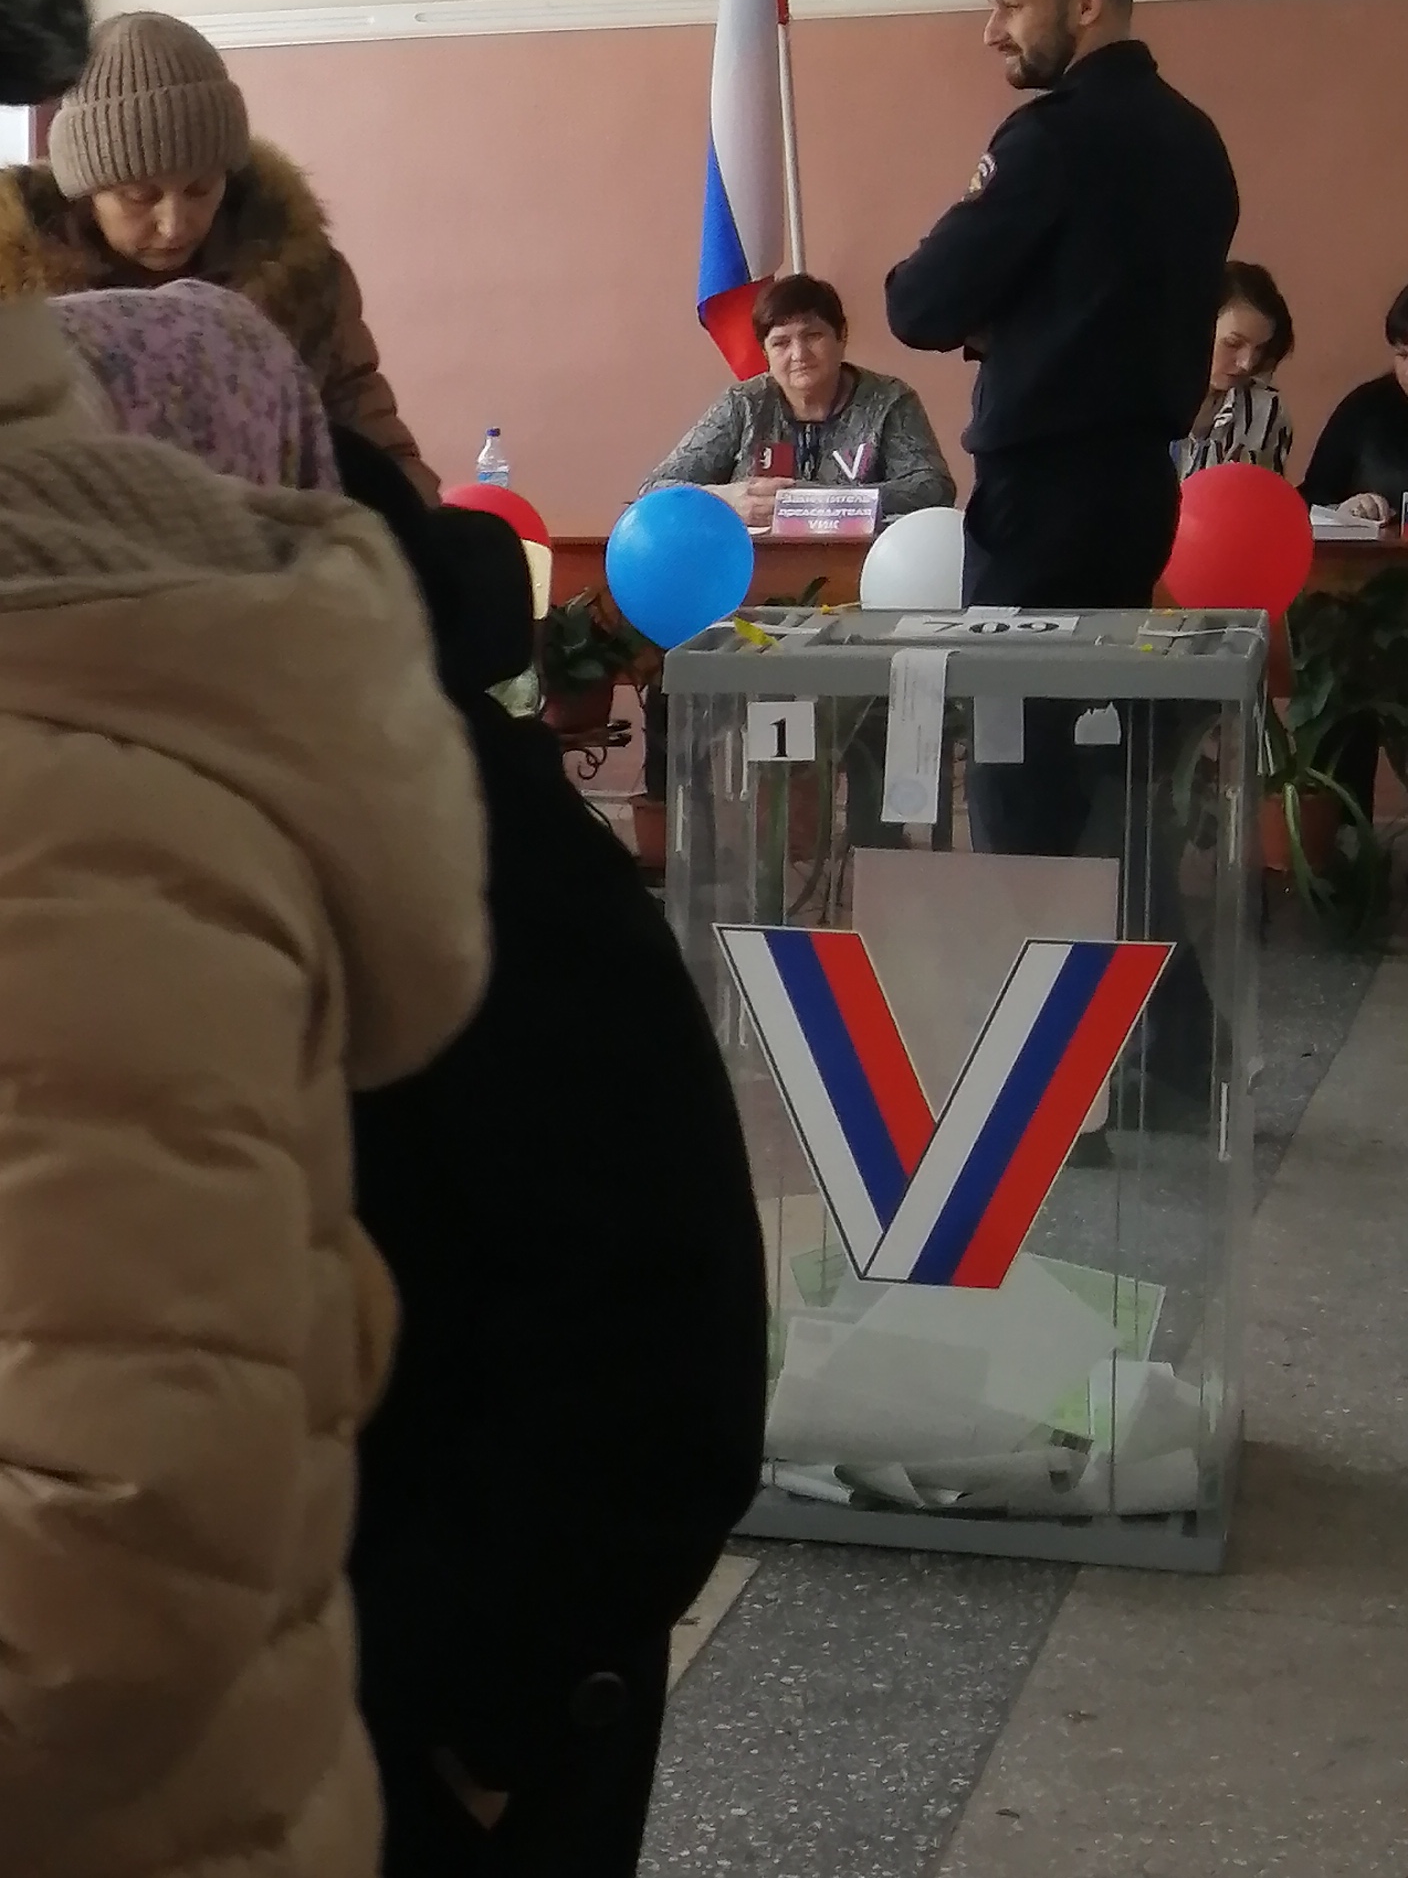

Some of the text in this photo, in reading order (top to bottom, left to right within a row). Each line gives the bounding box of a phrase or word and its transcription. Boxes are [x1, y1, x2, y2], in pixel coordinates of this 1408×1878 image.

[922, 620, 1060, 634] 709
[769, 716, 789, 758] 1
[713, 923, 1177, 1289] V
